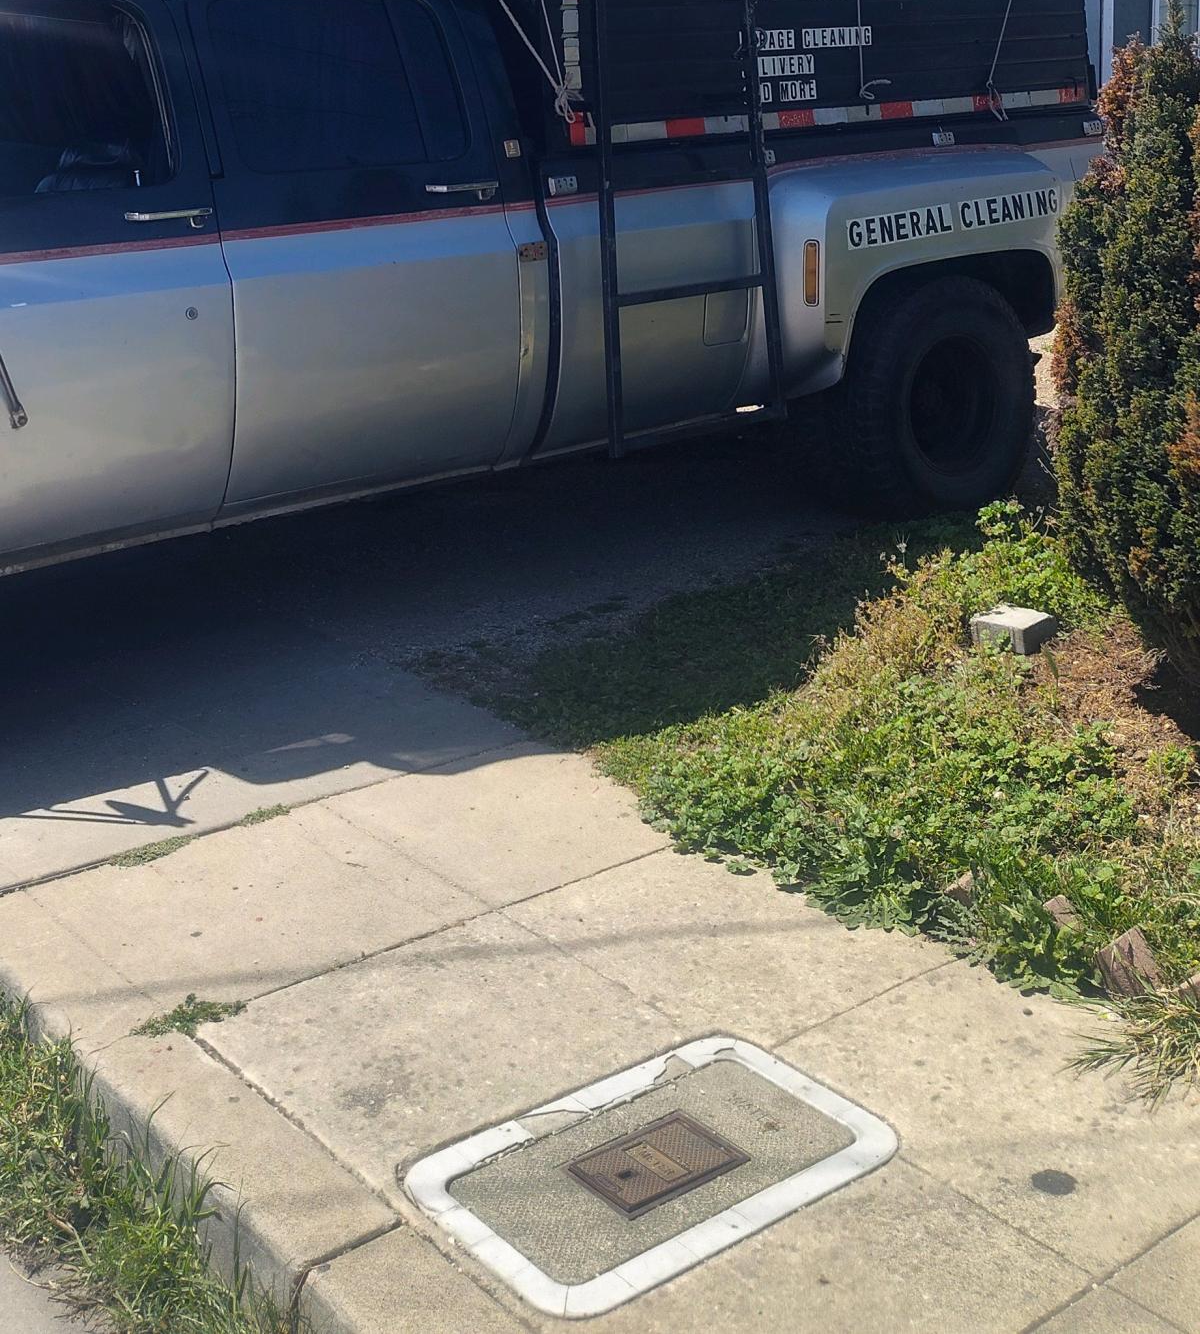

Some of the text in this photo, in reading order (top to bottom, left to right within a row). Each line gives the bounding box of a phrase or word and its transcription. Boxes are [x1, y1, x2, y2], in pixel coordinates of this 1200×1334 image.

[803, 27, 871, 48] CLEANING
[758, 55, 813, 76] LIVERY
[780, 81, 816, 101] MORE
[848, 188, 1058, 249] GENERAL CLEANING
